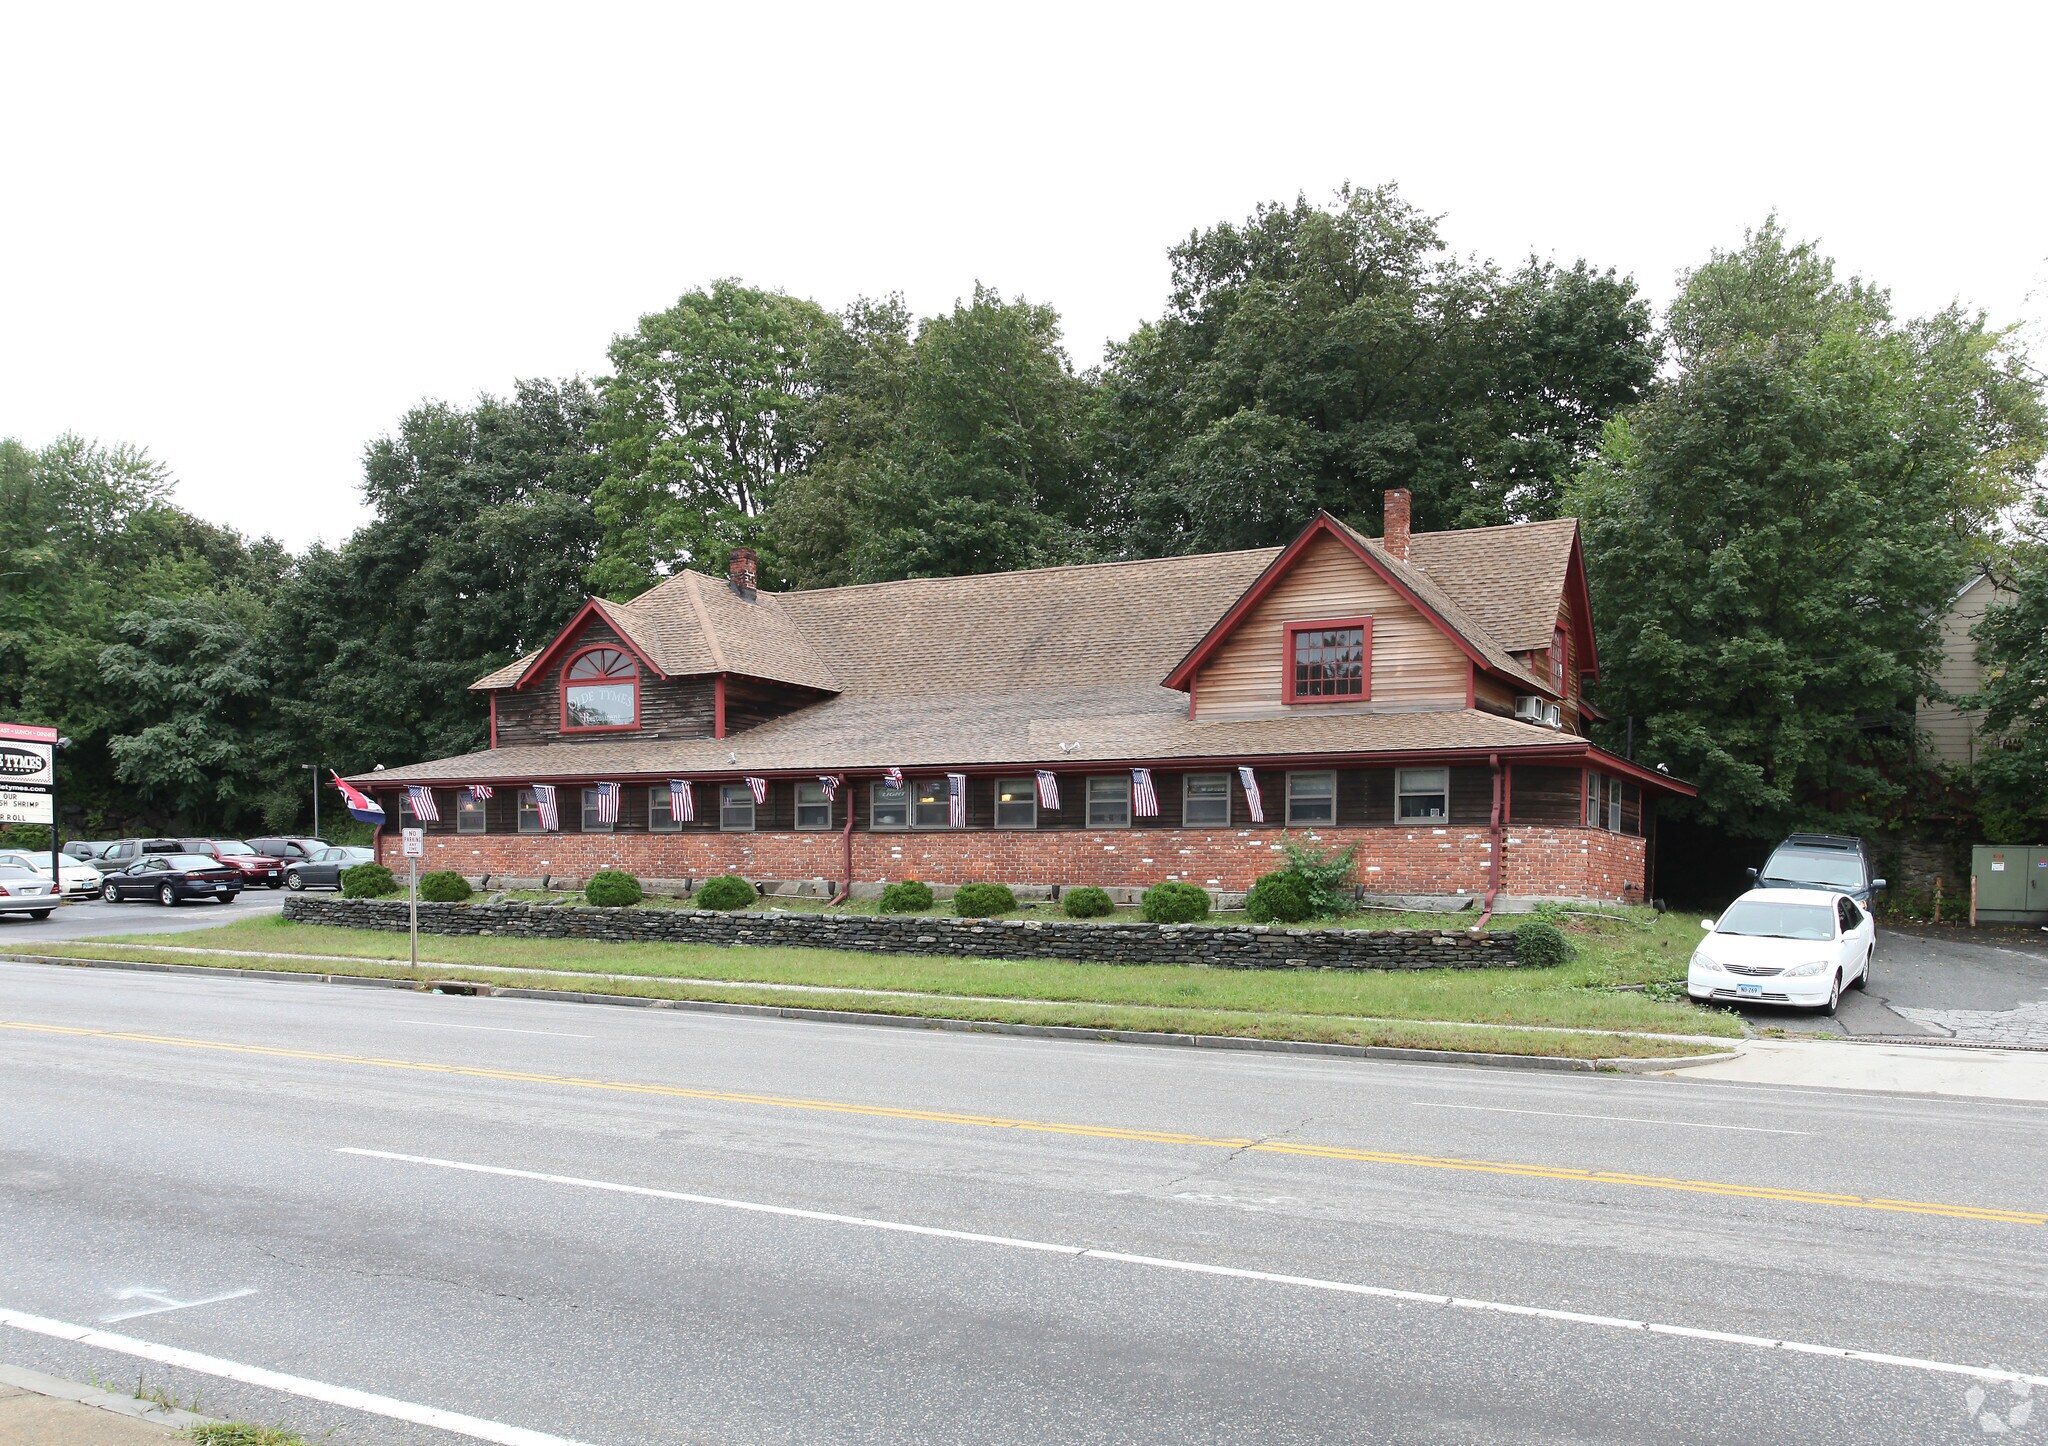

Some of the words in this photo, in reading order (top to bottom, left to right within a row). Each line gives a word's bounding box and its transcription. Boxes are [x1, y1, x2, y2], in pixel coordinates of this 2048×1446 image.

[568, 691, 594, 710] OLDE
[599, 690, 633, 707] TYMES
[5, 754, 42, 770] TYMES
